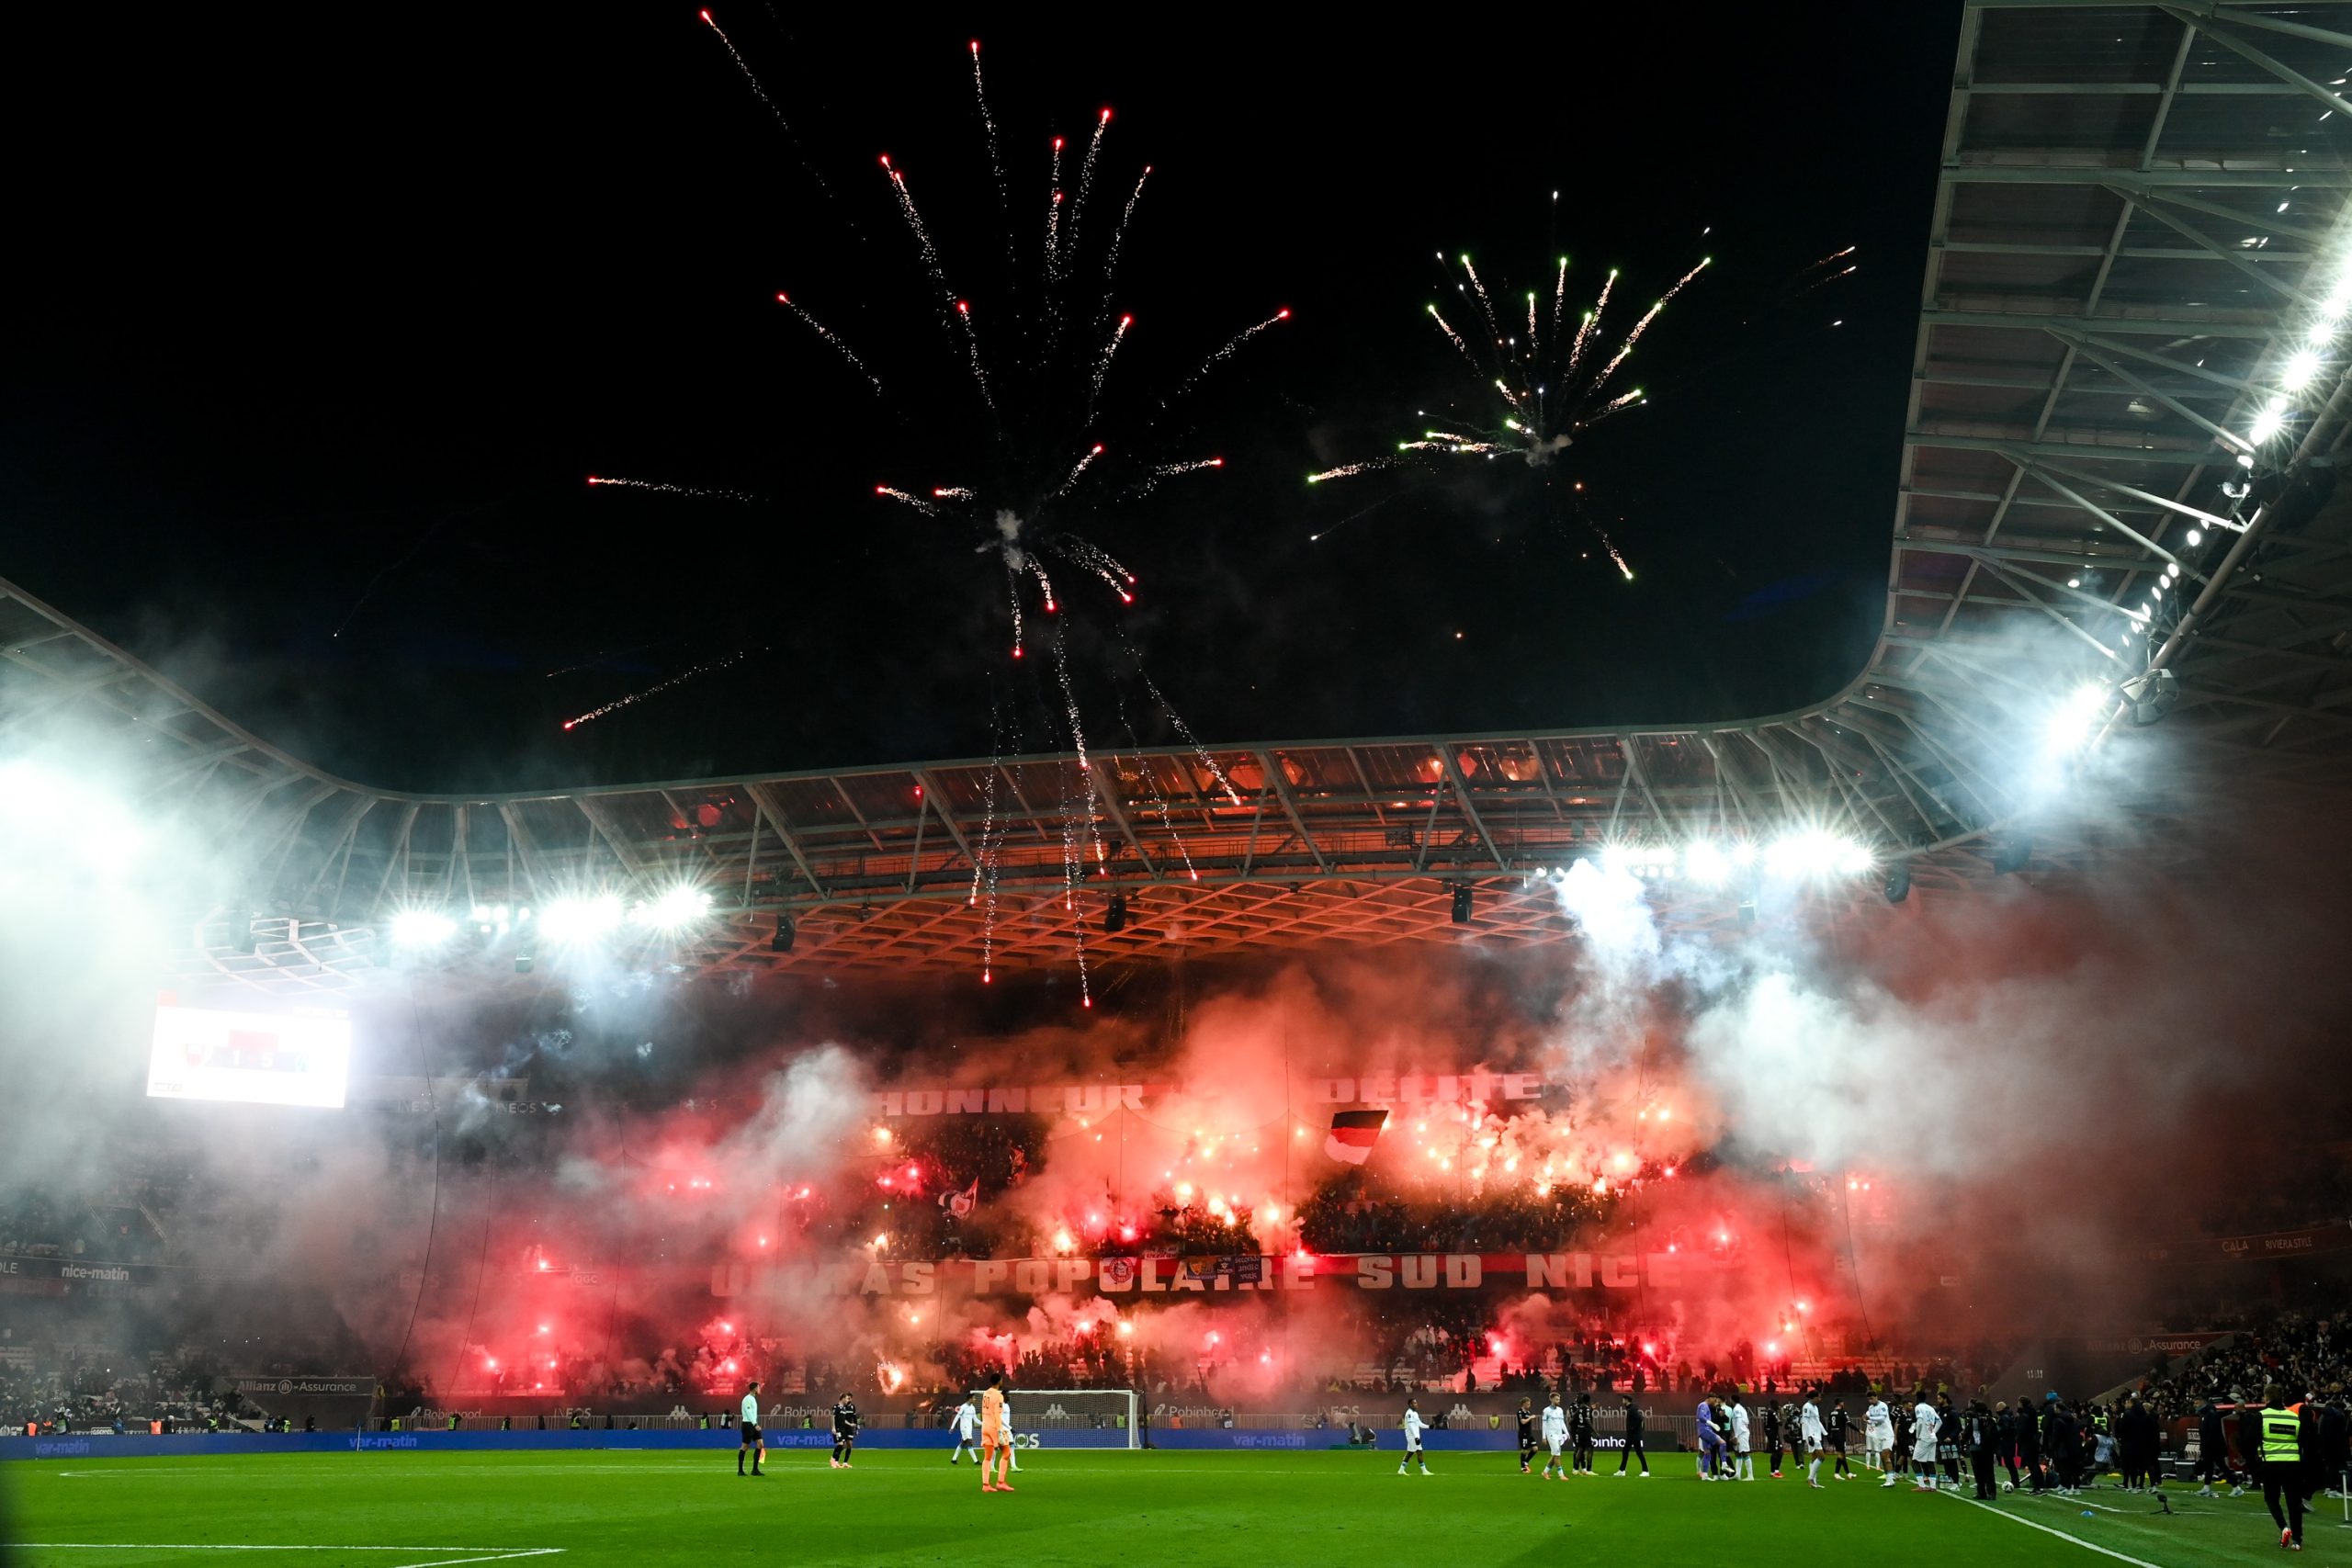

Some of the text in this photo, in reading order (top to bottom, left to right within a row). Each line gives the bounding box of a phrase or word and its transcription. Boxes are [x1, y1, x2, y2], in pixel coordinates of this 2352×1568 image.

[1317, 1072, 1542, 1103] DELITE
[2222, 1240, 2249, 1252] CALA
[62, 1264, 130, 1280] nice-matin
[711, 1262, 936, 1296] URAS
[1357, 1254, 1482, 1289] SUD
[1526, 1252, 1681, 1289] NICE
[238, 1380, 276, 1392] Allianz
[784, 1406, 832, 1417] Robinho
[1591, 1406, 1653, 1419] obinhod
[36, 1439, 89, 1454] var-matin
[349, 1435, 417, 1449] var-matin
[1233, 1433, 1306, 1447] var-matin
